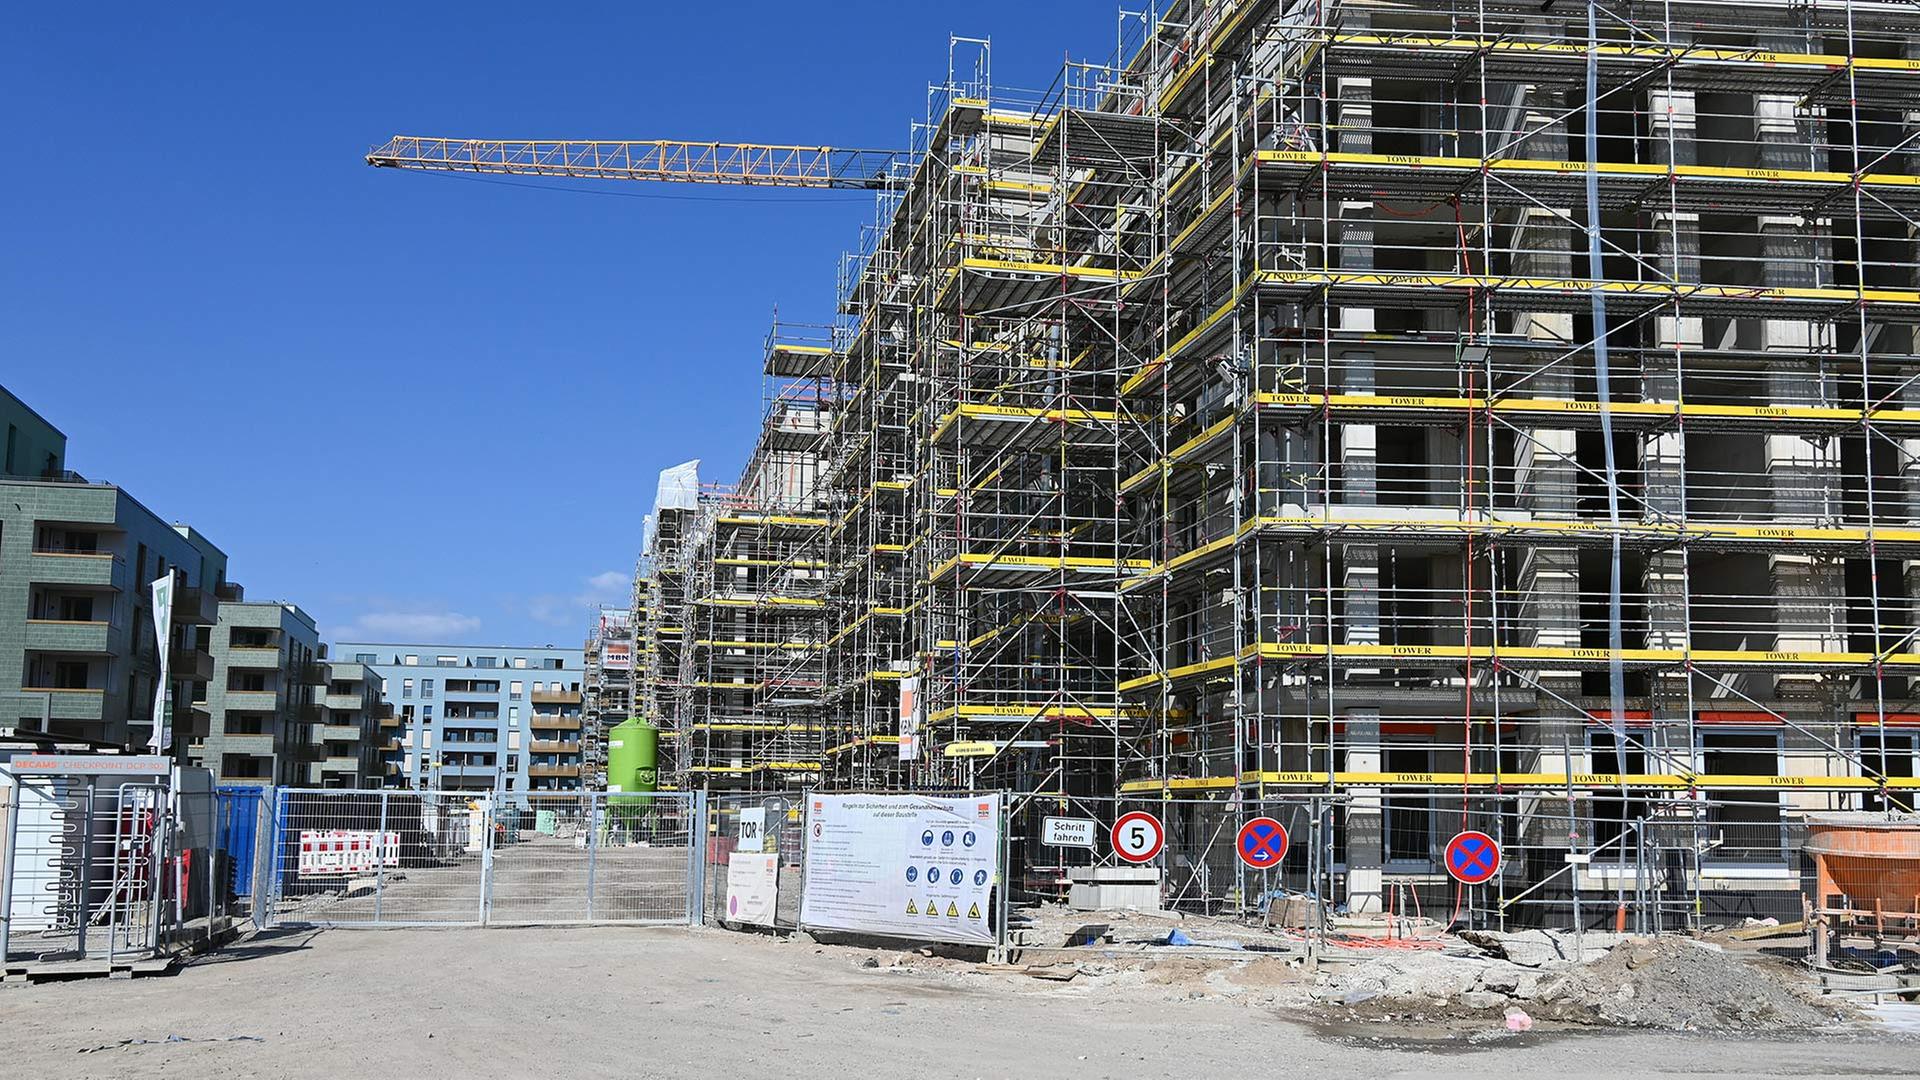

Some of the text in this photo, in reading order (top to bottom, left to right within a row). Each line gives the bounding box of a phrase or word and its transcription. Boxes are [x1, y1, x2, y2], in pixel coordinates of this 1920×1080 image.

[1746, 170, 1779, 178] TOWER
[1271, 395, 1310, 403] TOWER
[1390, 397, 1425, 405] TOWER
[1754, 407, 1788, 415] TOWER
[1756, 529, 1795, 537] TOWER
[1276, 644, 1312, 652] TOWER
[1391, 646, 1432, 654] TOWER
[1571, 649, 1610, 658] TOWER
[1765, 652, 1799, 660] TOWER
[1276, 773, 1313, 781] TOWER
[1396, 774, 1433, 782] TOWER
[1573, 775, 1612, 783] TOWER
[741, 822, 757, 838] TOR
[1054, 822, 1086, 832] Schritt
[1053, 832, 1084, 843] fahren
[1131, 827, 1145, 849] 5
